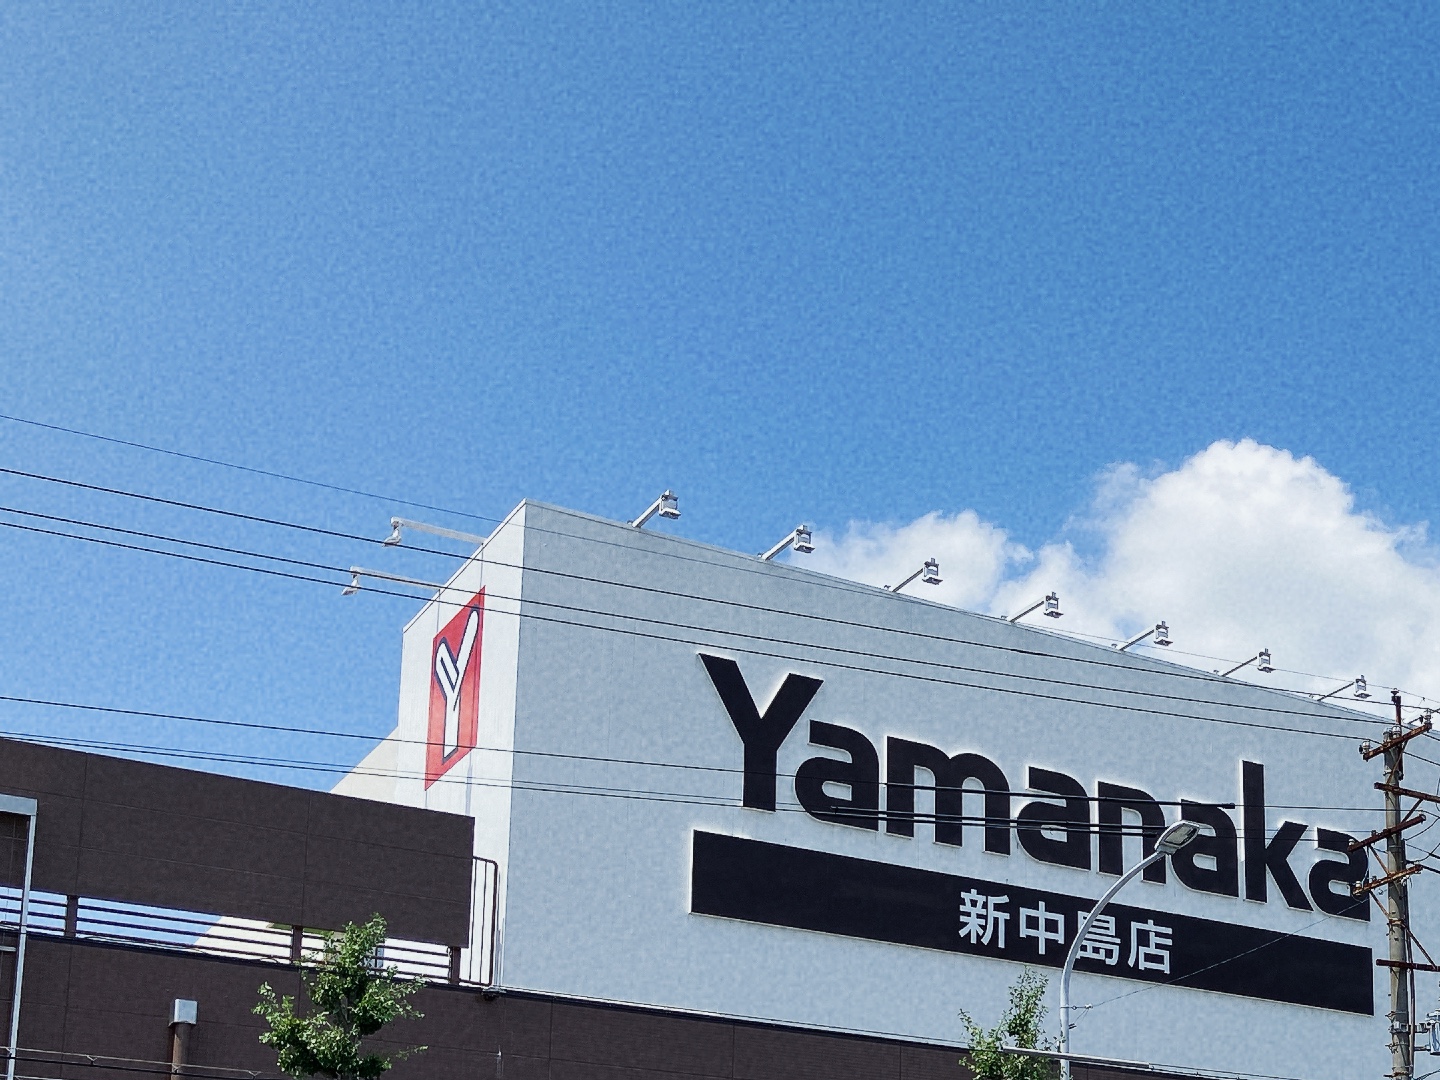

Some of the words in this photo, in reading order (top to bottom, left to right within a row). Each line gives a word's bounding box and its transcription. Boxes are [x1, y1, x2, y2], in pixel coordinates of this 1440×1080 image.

[698, 652, 1371, 921] Yamanaka
[958, 888, 1173, 975] 新中島店
